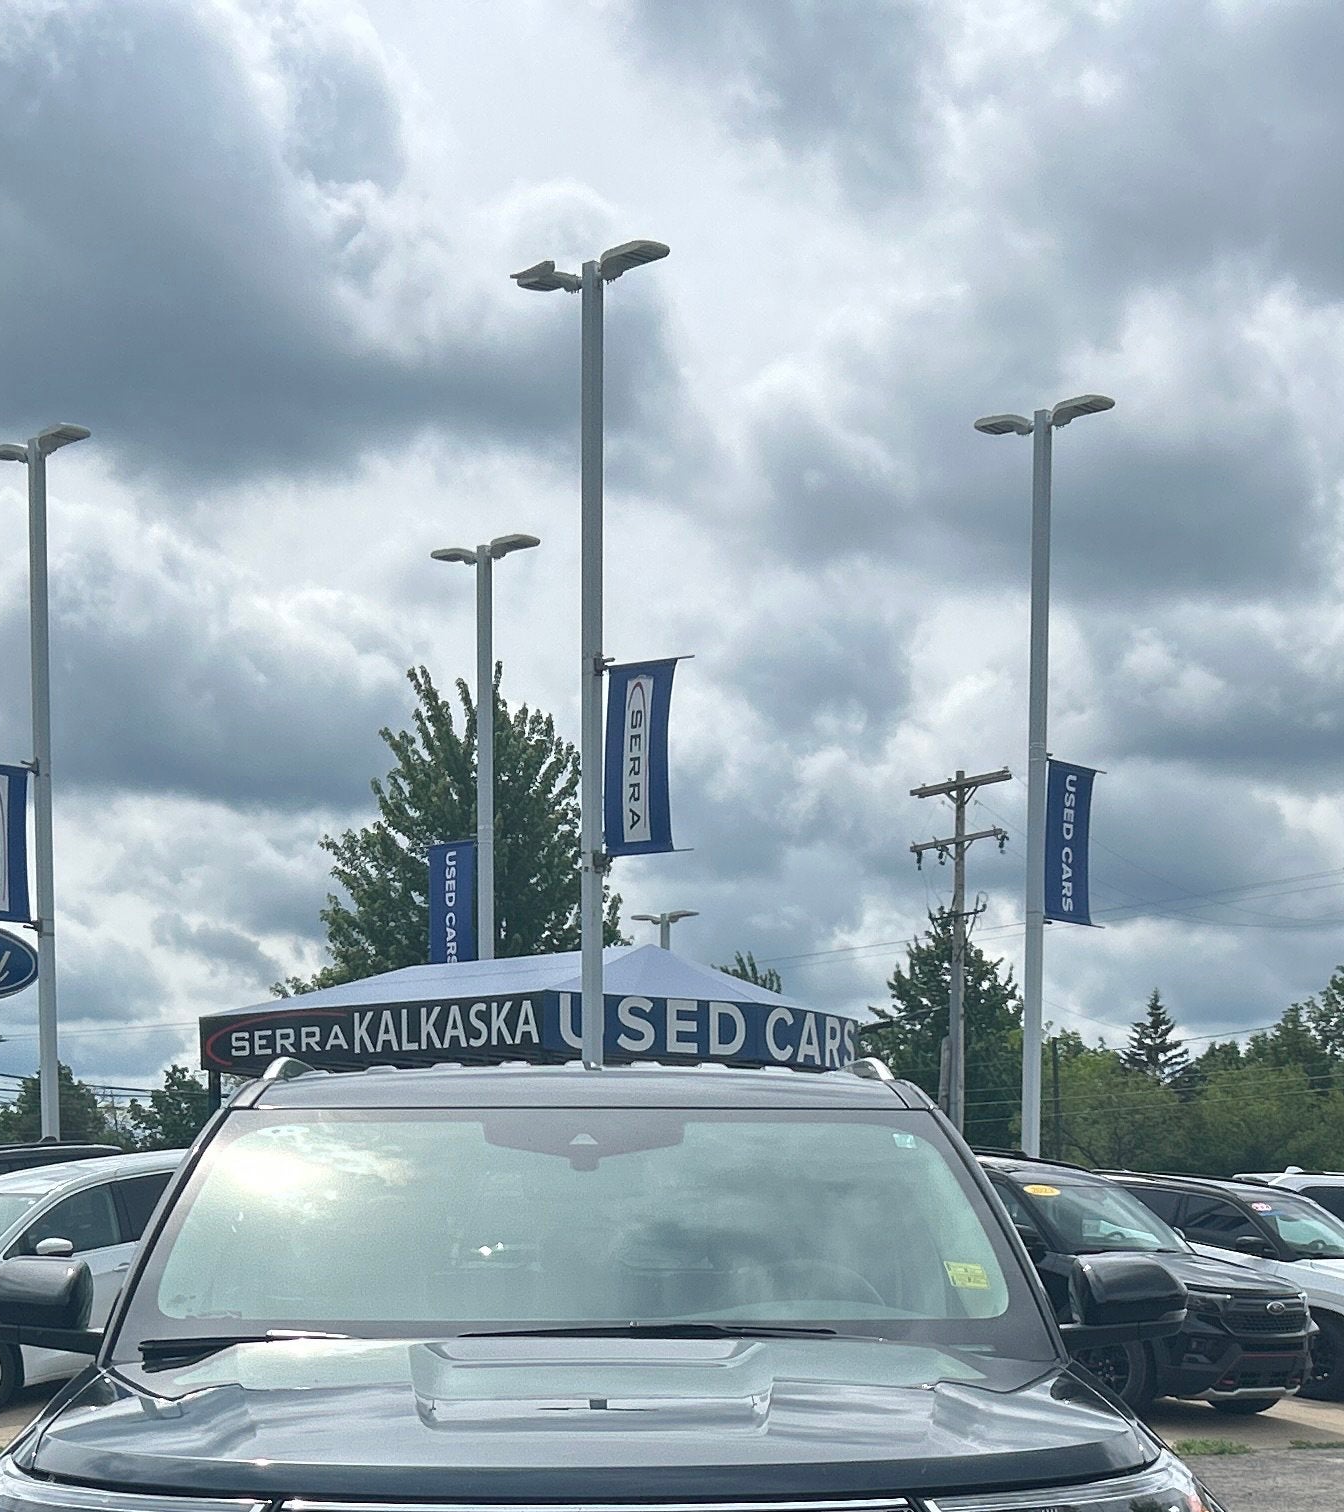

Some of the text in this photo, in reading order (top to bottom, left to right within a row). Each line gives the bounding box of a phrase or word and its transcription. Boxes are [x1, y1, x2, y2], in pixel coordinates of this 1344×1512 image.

[628, 709, 643, 831] SERRA
[1061, 774, 1077, 912] USED CARS
[445, 850, 457, 907] USED
[231, 999, 540, 1057] SERRA KALKASKA
[765, 1006, 855, 1067] CARS
